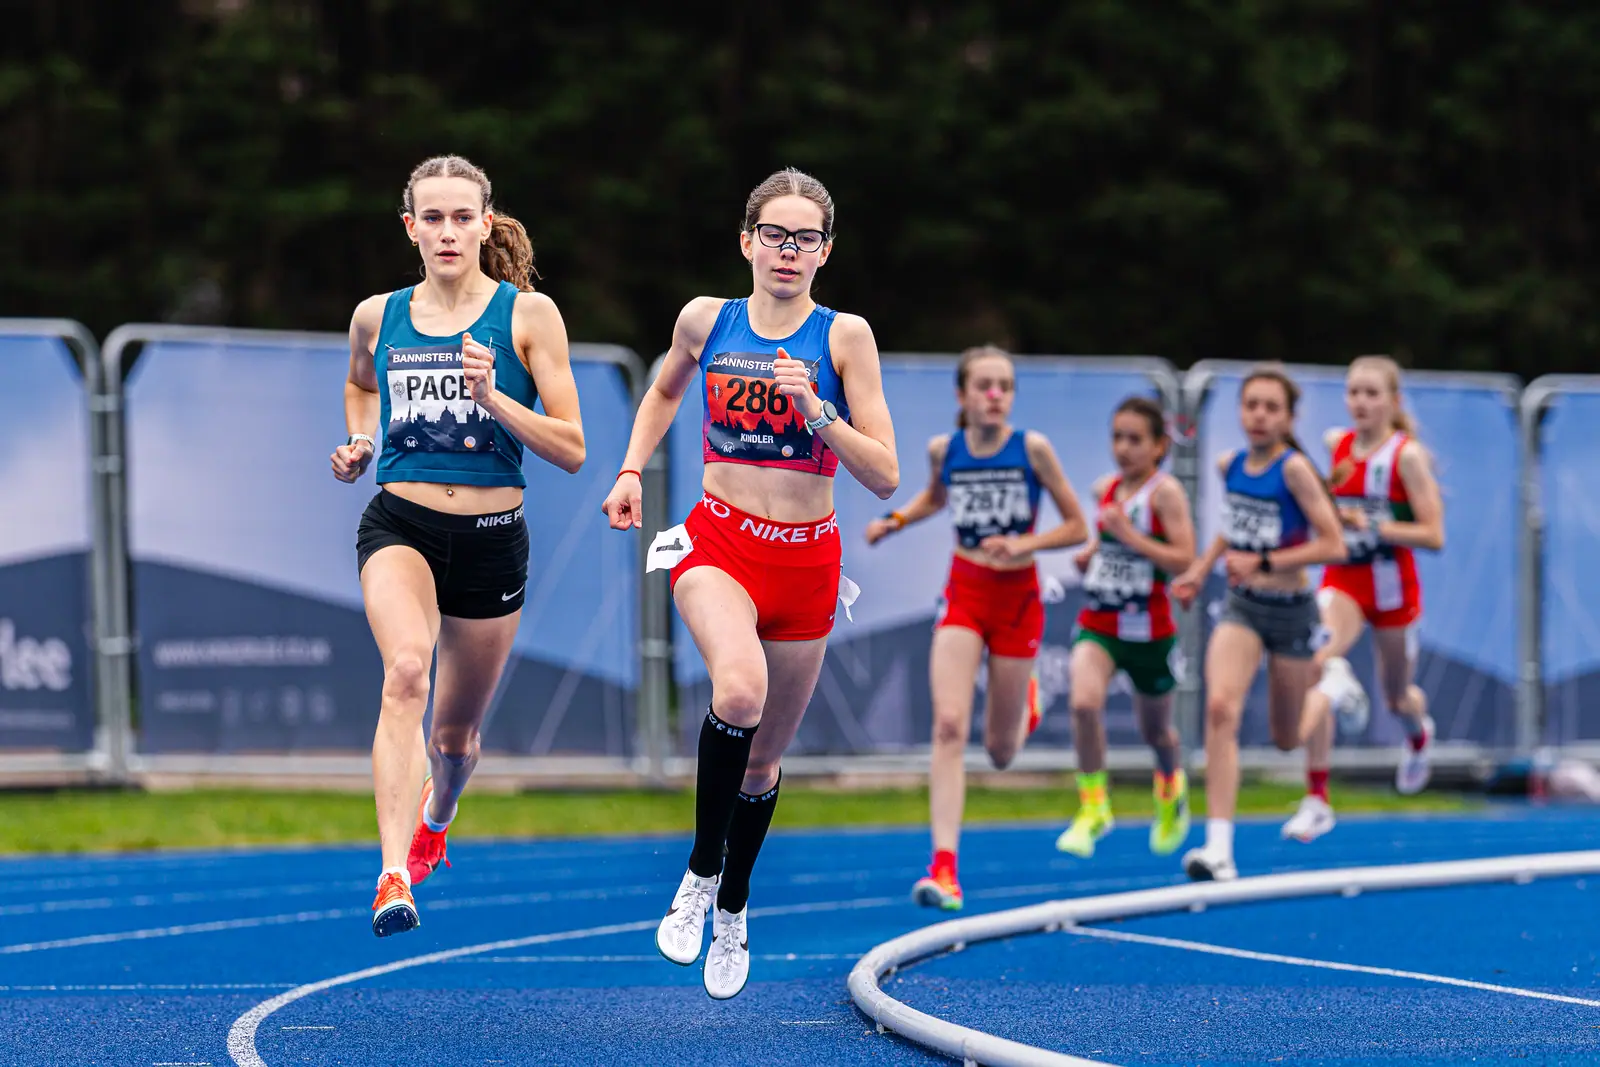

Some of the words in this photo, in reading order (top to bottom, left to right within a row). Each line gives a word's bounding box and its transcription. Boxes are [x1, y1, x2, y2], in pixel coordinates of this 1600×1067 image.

[392, 353, 453, 363] BANNISTER
[726, 377, 788, 415] 286
[740, 433, 774, 444] KINDLER
[476, 513, 513, 528] NIKE
[739, 518, 809, 543] NIKE
